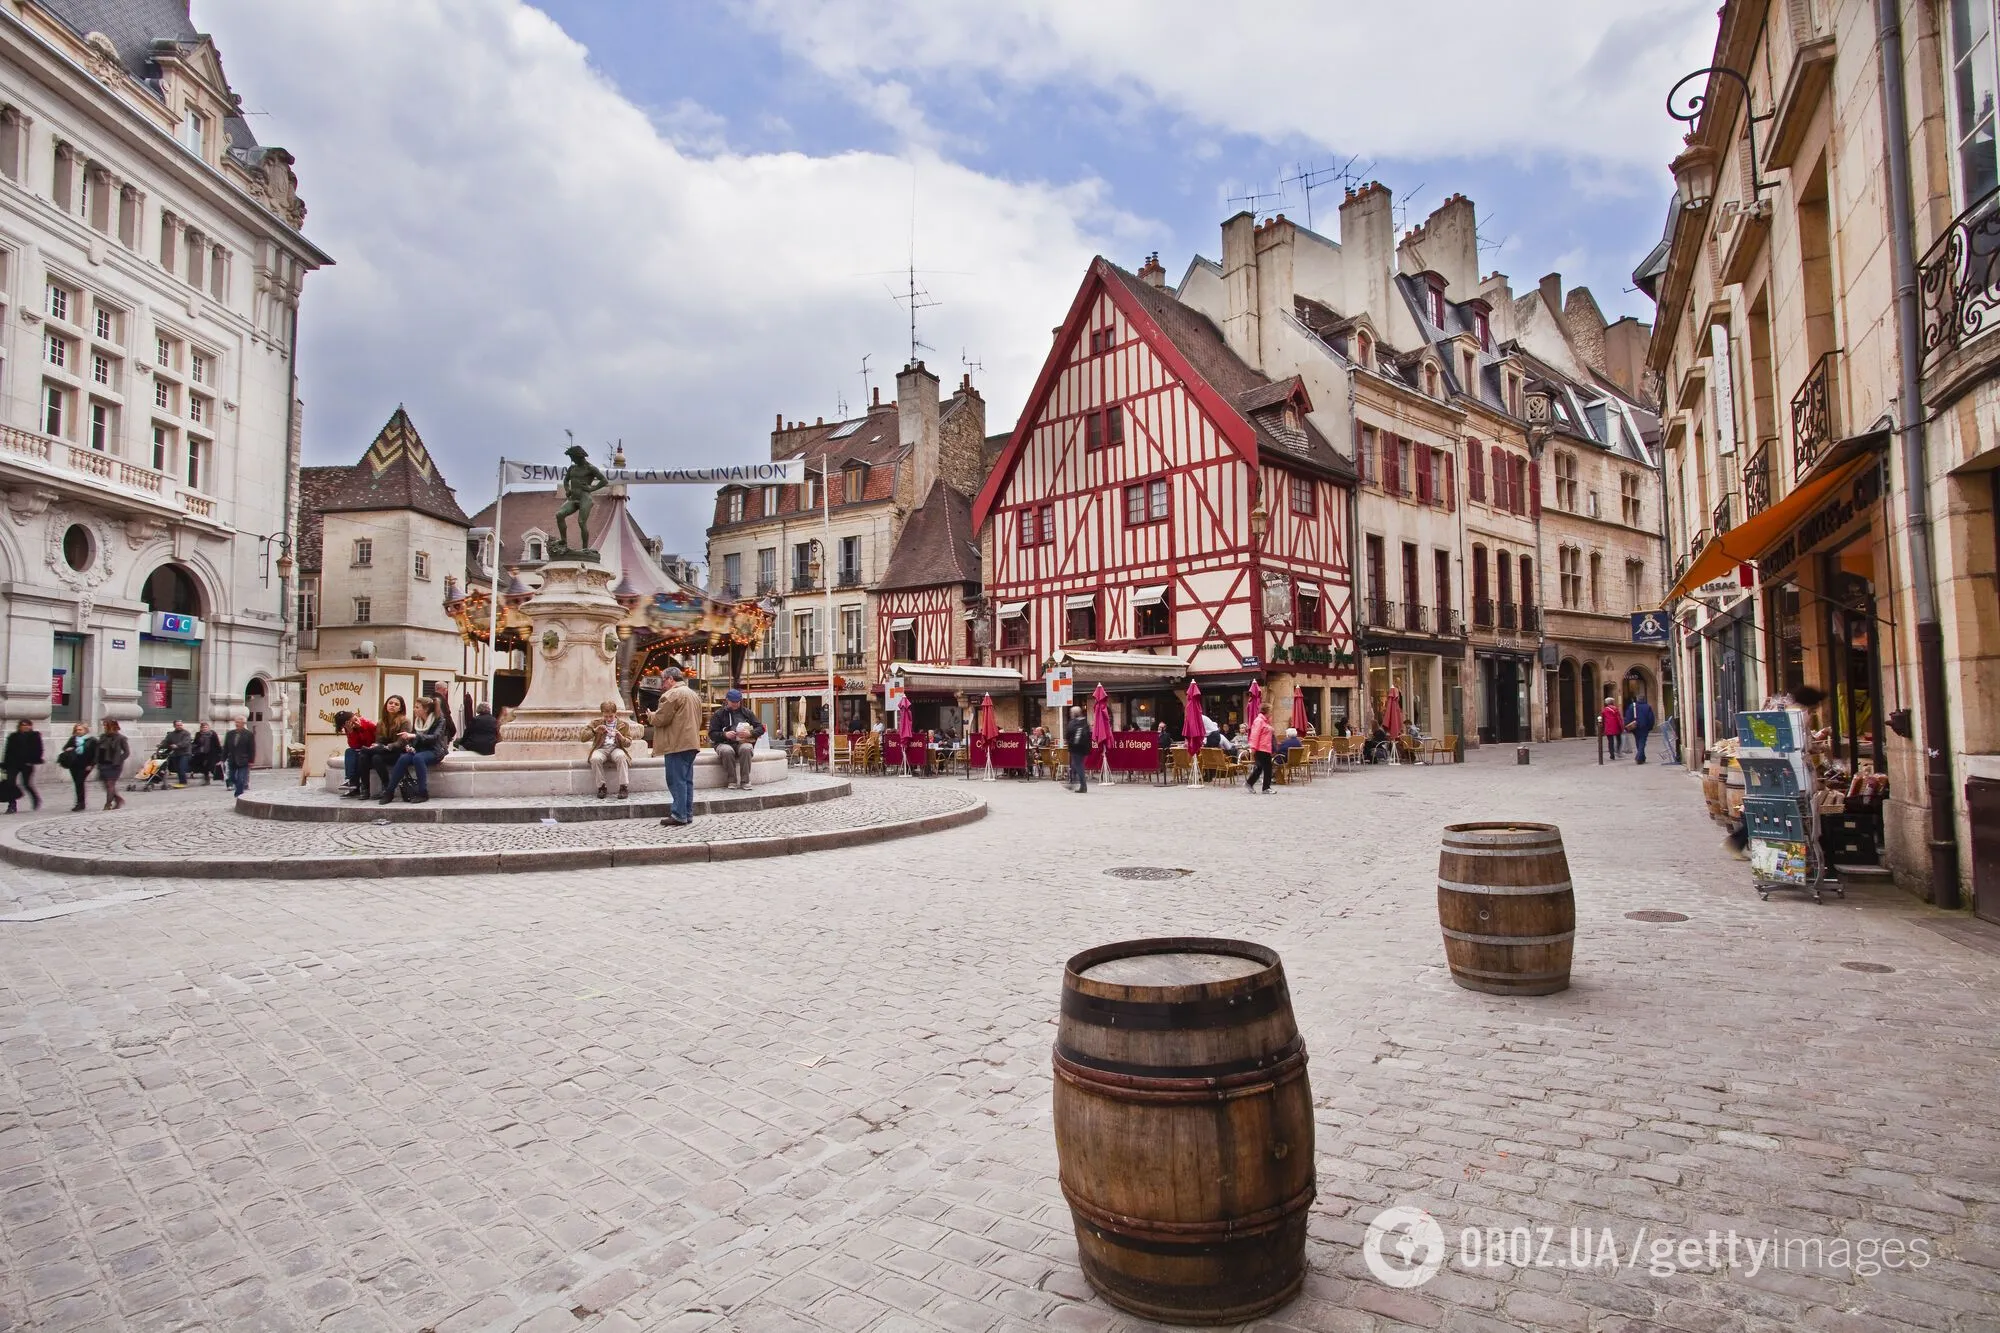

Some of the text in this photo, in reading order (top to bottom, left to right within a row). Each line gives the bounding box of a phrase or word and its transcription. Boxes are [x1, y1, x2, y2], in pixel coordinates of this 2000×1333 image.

[663, 464, 787, 480] VACCINATION
[1700, 582, 1737, 592] LISSAC
[166, 617, 190, 630] CIC
[319, 681, 363, 696] Carrousel
[332, 697, 350, 706] 1900
[888, 740, 897, 748] Bar
[996, 739, 1020, 749] Glacier
[1119, 739, 1124, 748] à
[1125, 739, 1152, 750] l'étage
